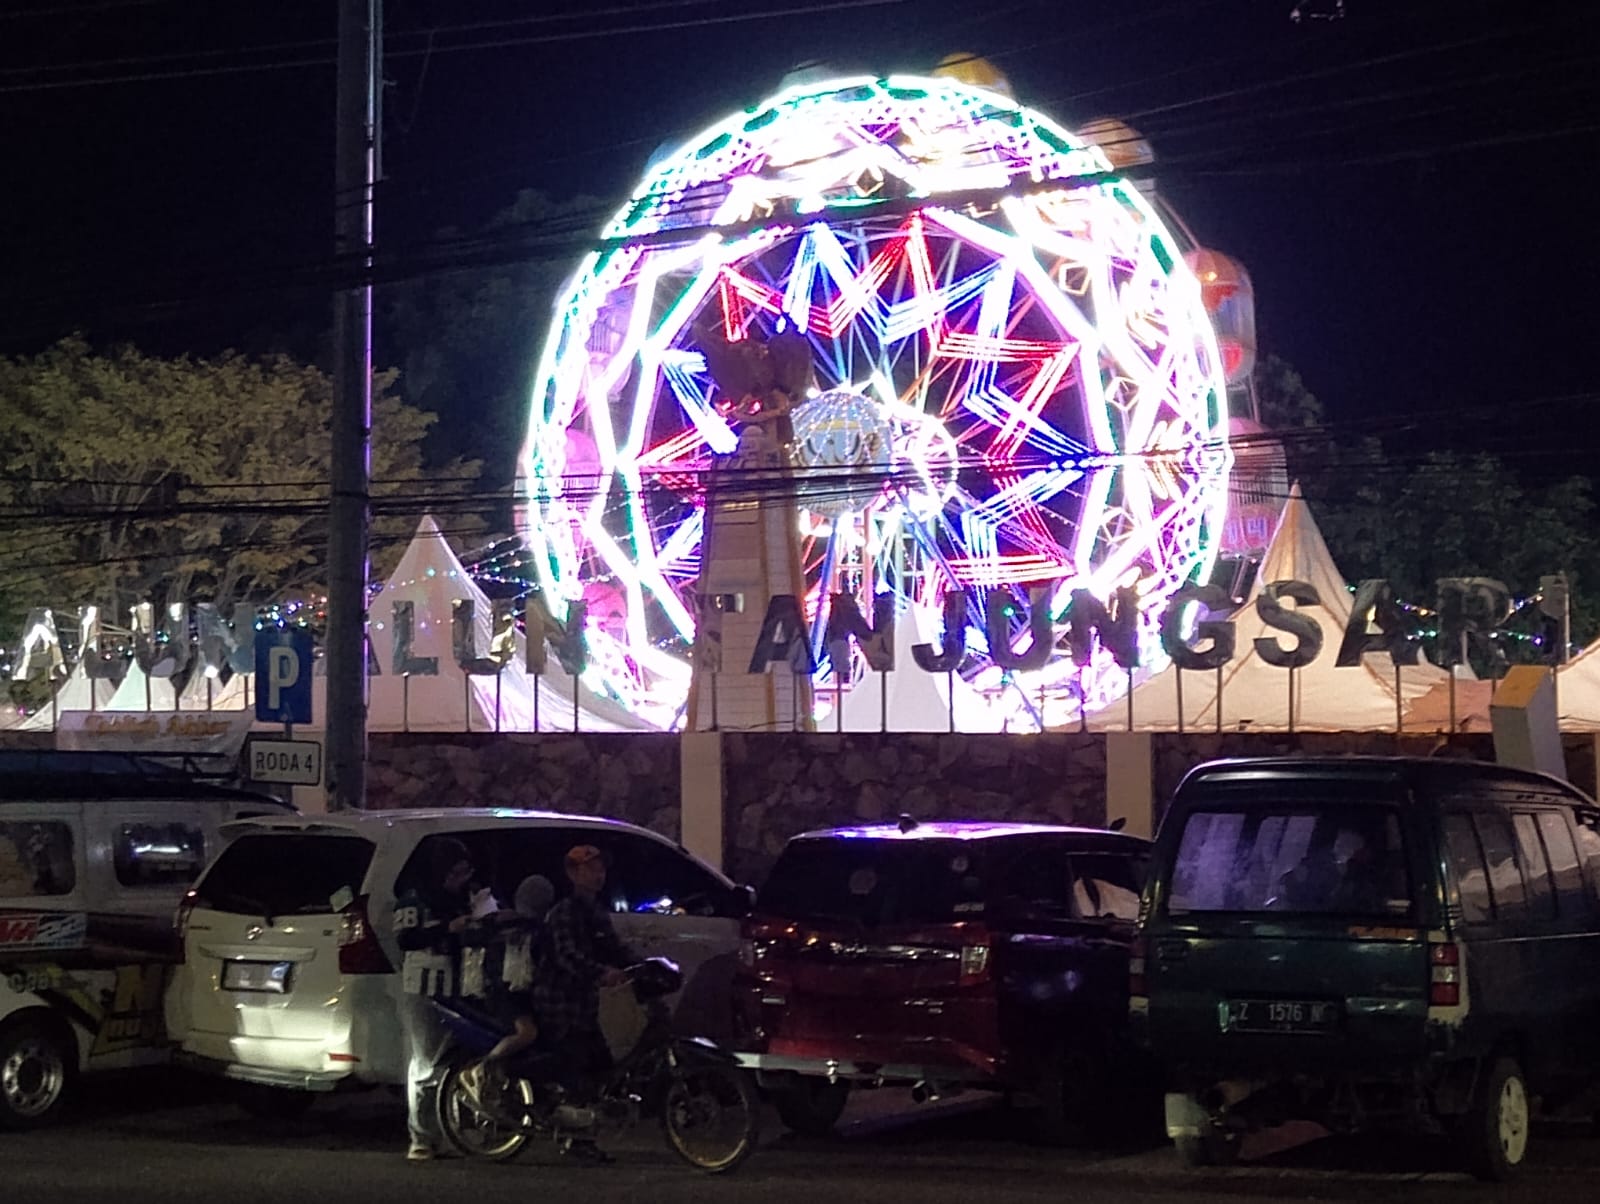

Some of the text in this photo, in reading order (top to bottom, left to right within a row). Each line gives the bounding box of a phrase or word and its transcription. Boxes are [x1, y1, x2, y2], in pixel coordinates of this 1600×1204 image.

[268, 646, 300, 709] P
[255, 752, 313, 774] RODA 4
[1240, 1002, 1249, 1021] Z
[1269, 1003, 1303, 1022] 1576
